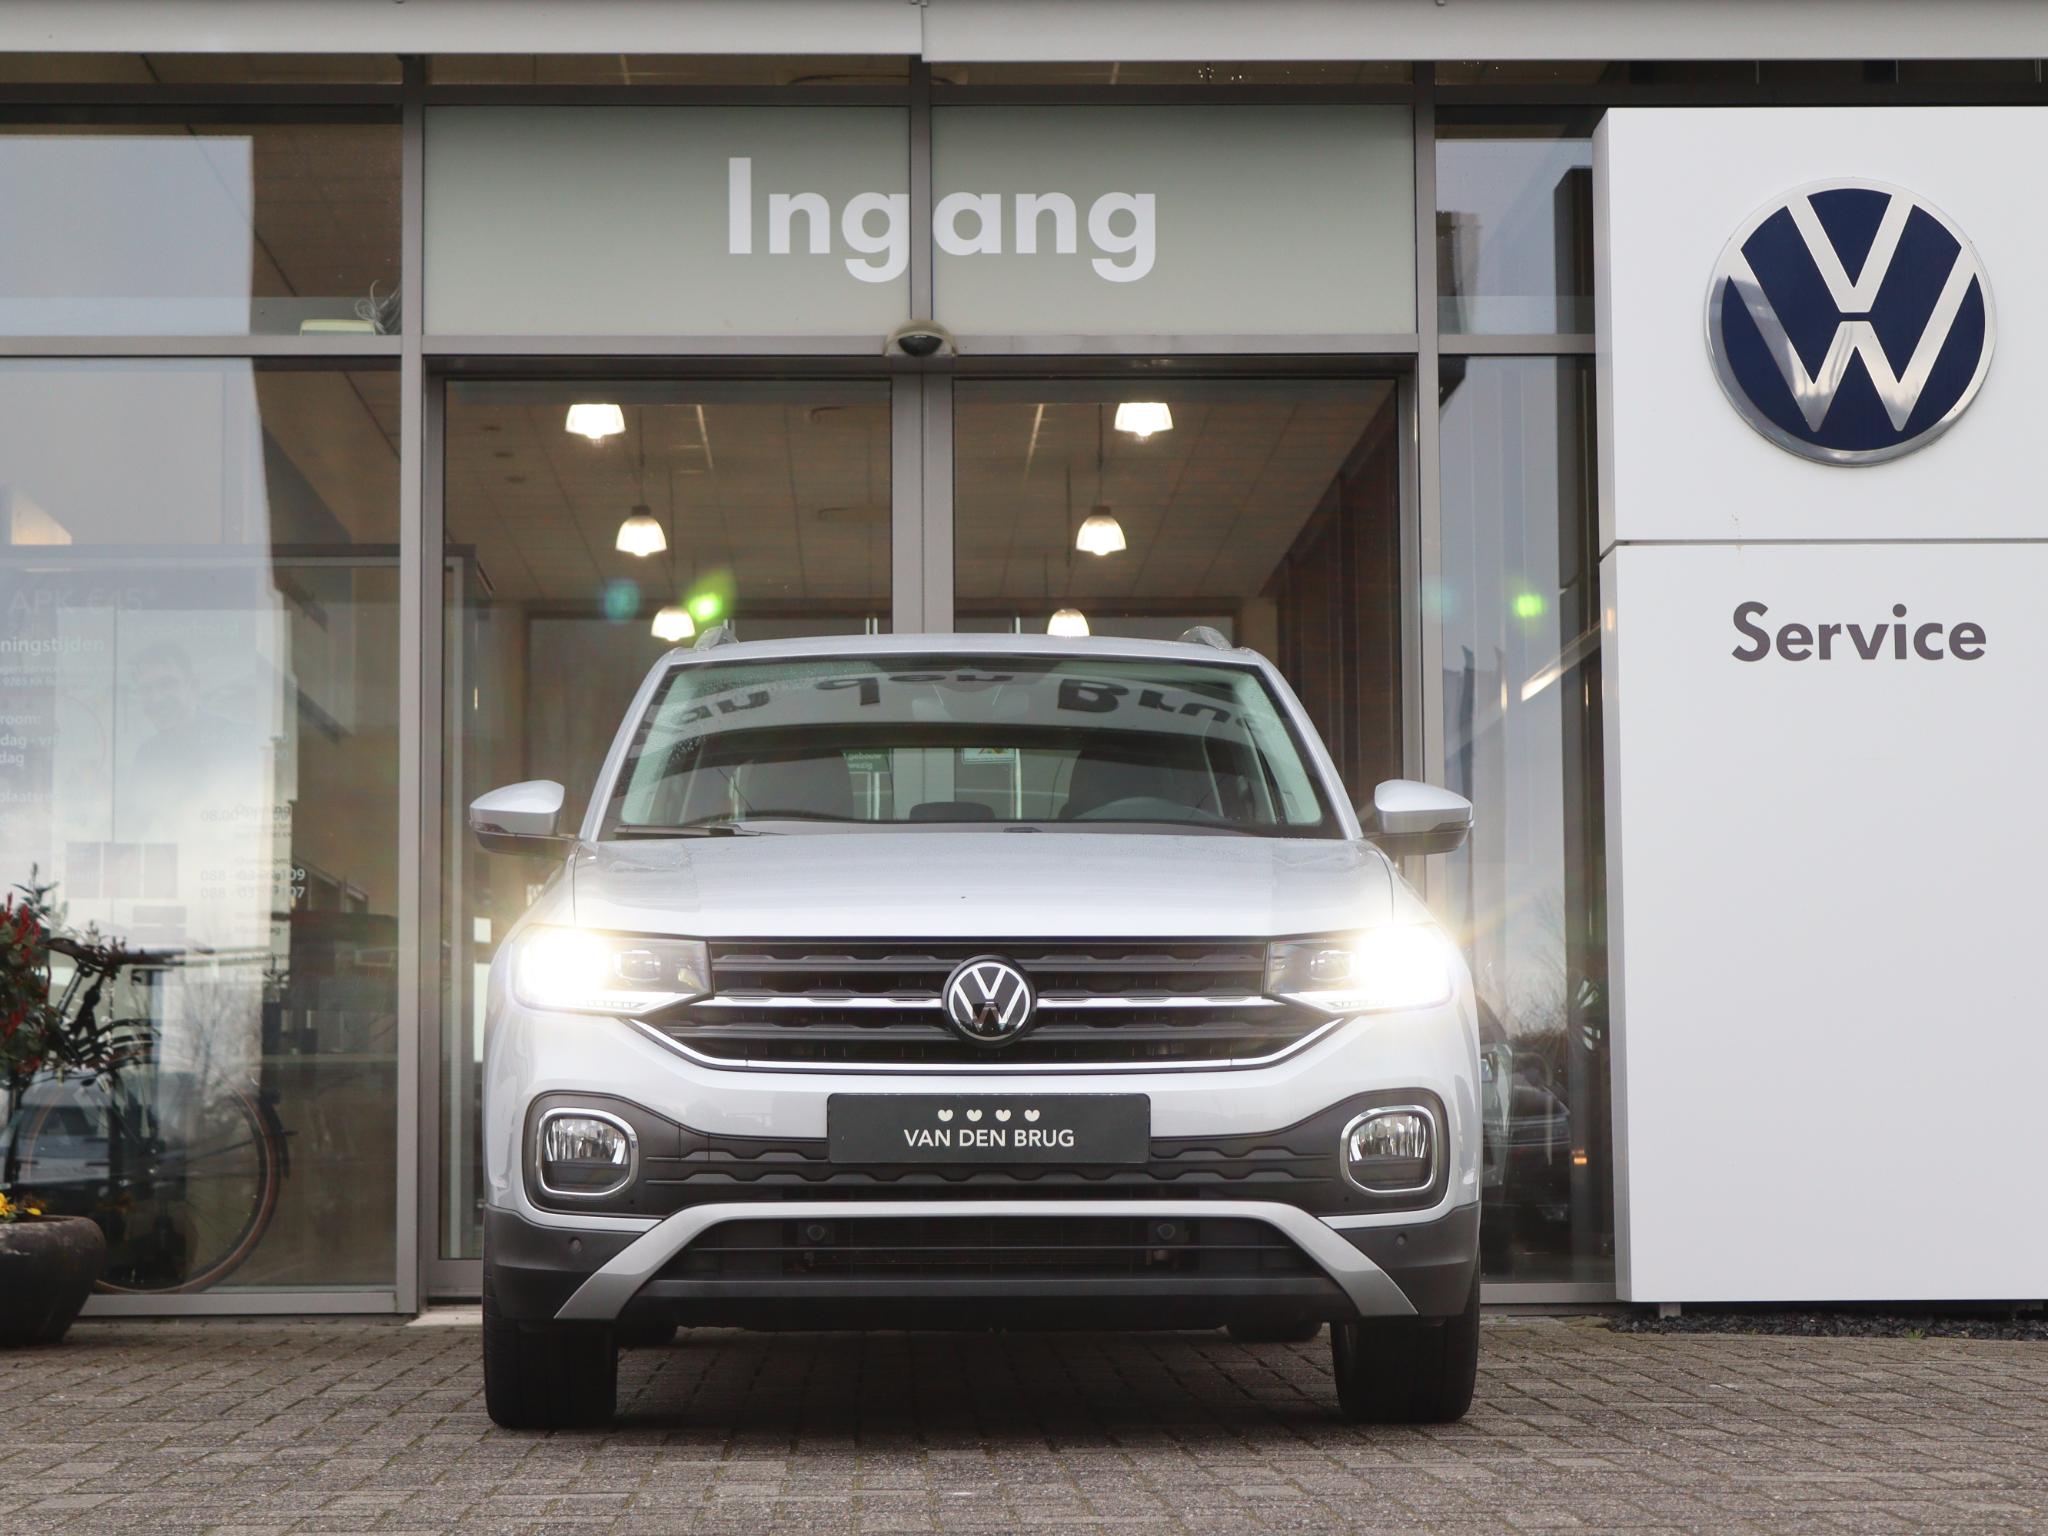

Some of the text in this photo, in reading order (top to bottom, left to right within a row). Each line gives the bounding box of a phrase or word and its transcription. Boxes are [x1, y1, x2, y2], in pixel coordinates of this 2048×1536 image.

[728, 156, 1157, 283] Ingang
[1715, 187, 1985, 434] VW
[1731, 600, 1987, 662] Service
[903, 1129, 1075, 1148] VAN DEN BRUG
